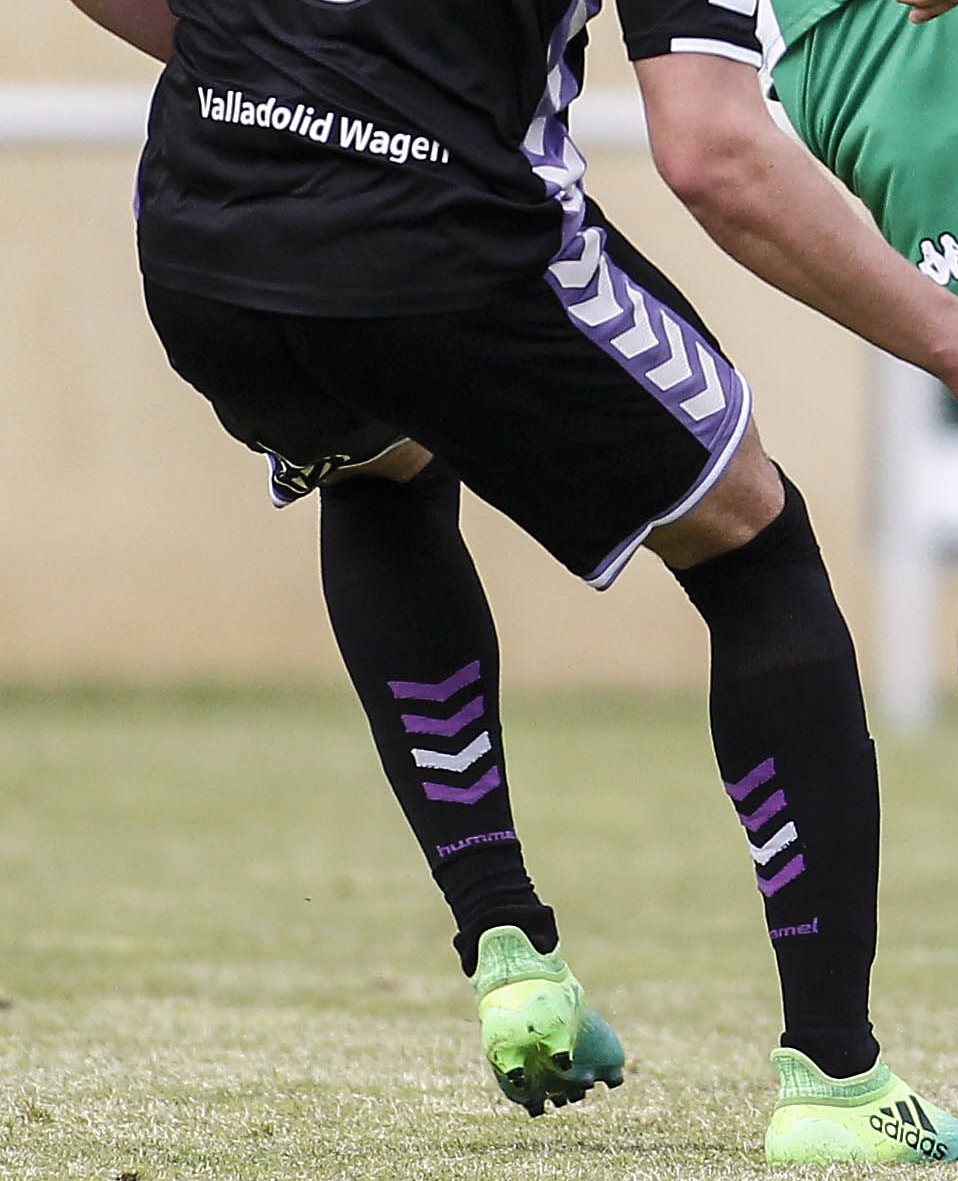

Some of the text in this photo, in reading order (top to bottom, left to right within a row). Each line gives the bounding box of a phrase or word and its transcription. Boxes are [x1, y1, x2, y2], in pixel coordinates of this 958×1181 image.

[198, 86, 449, 164] Valladolid Wagen
[436, 830, 516, 858] humme
[870, 1114, 948, 1160] adidas
